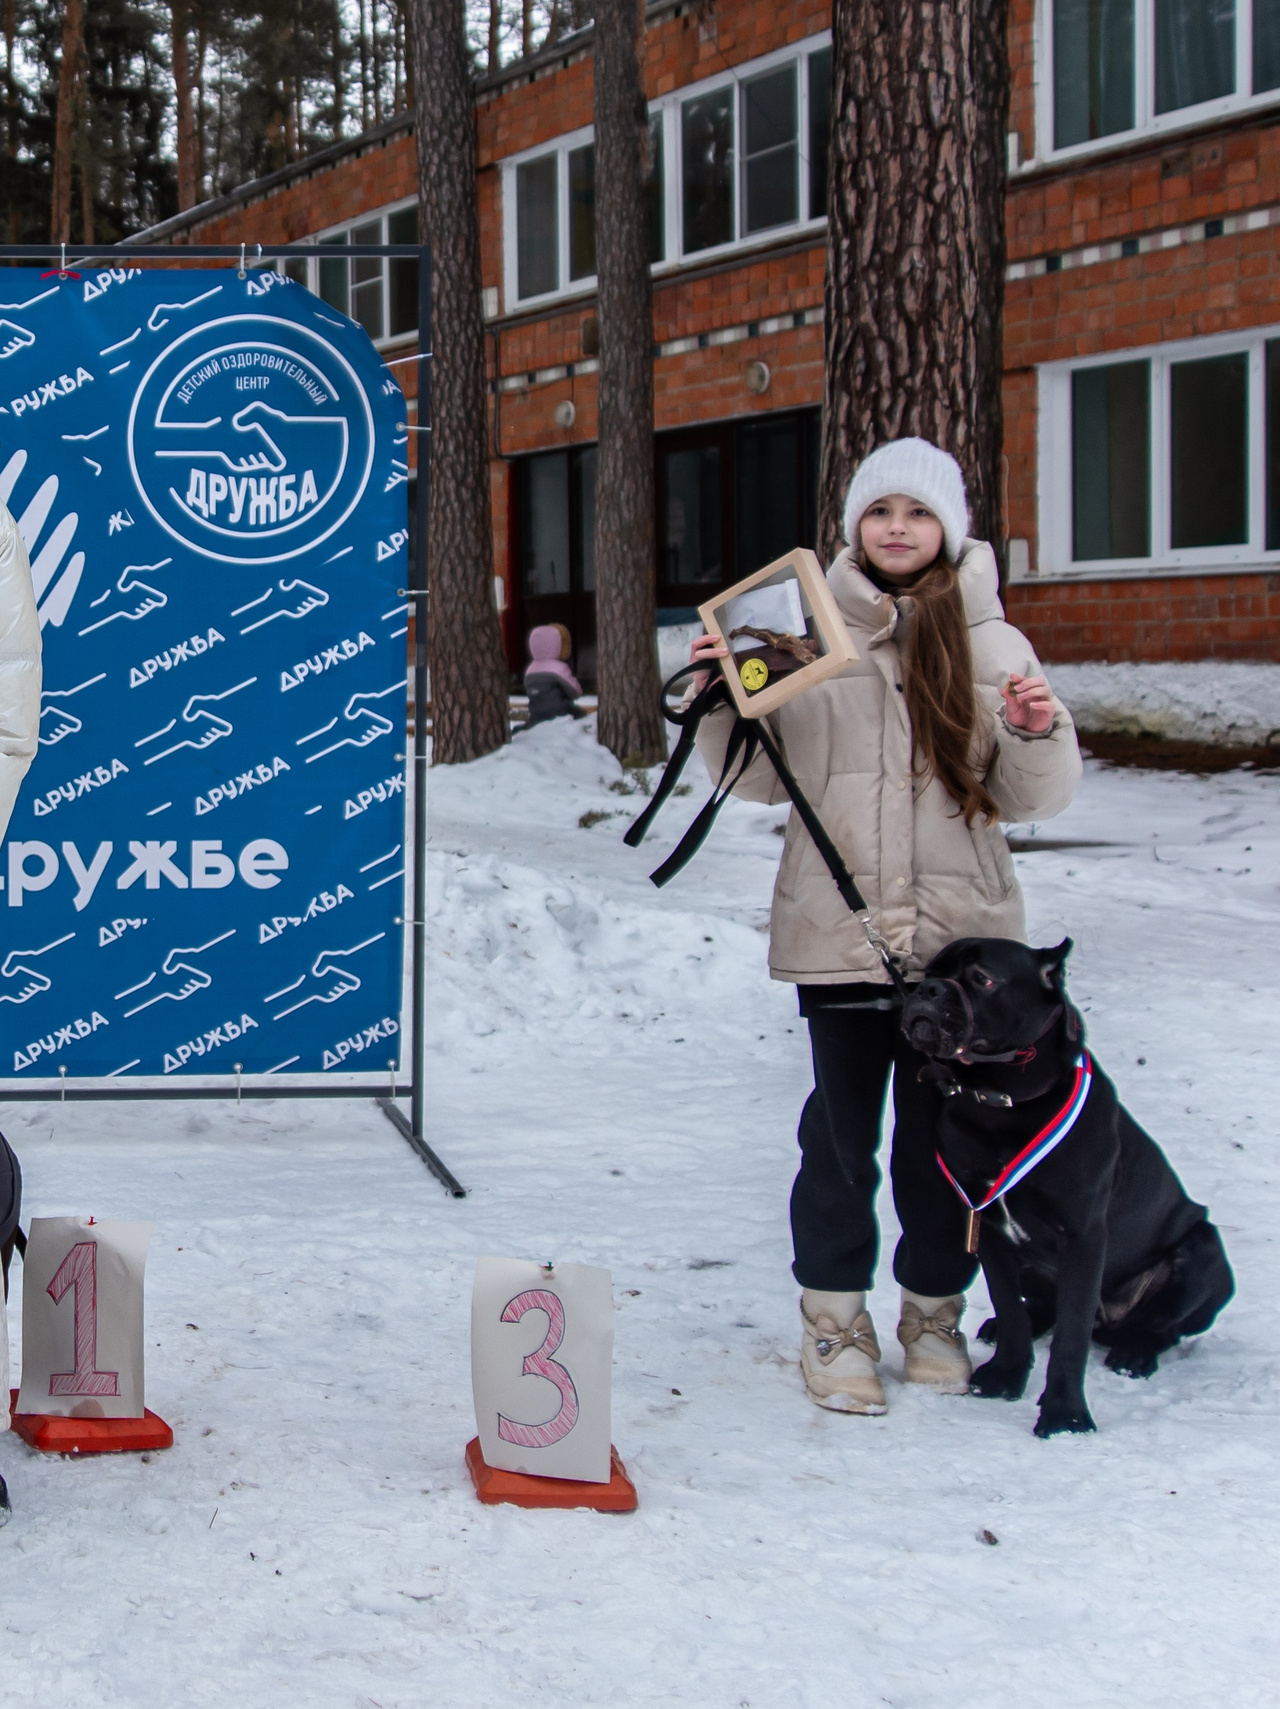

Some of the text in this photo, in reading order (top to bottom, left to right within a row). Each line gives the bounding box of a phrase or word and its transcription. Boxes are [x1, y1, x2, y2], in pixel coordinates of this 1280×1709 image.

[0, 367, 94, 416] РУЖБА
[177, 352, 328, 405] ДЕТСКИЙ ОЗДОРОВИТЕЛЬНЫЙ
[235, 376, 270, 391] ЦЕНТР
[186, 467, 319, 525] ДРУЖБА
[130, 628, 225, 688] ДРУЖБА
[281, 631, 375, 692] ДРУЖБА
[34, 758, 129, 816] ДРУЖБА
[195, 757, 290, 816] ДРУЖБА
[13, 1011, 109, 1071] ДРУЖБА
[163, 1013, 258, 1073] ДРУЖБА
[46, 1241, 120, 1397] 1
[497, 1289, 579, 1449] 3
